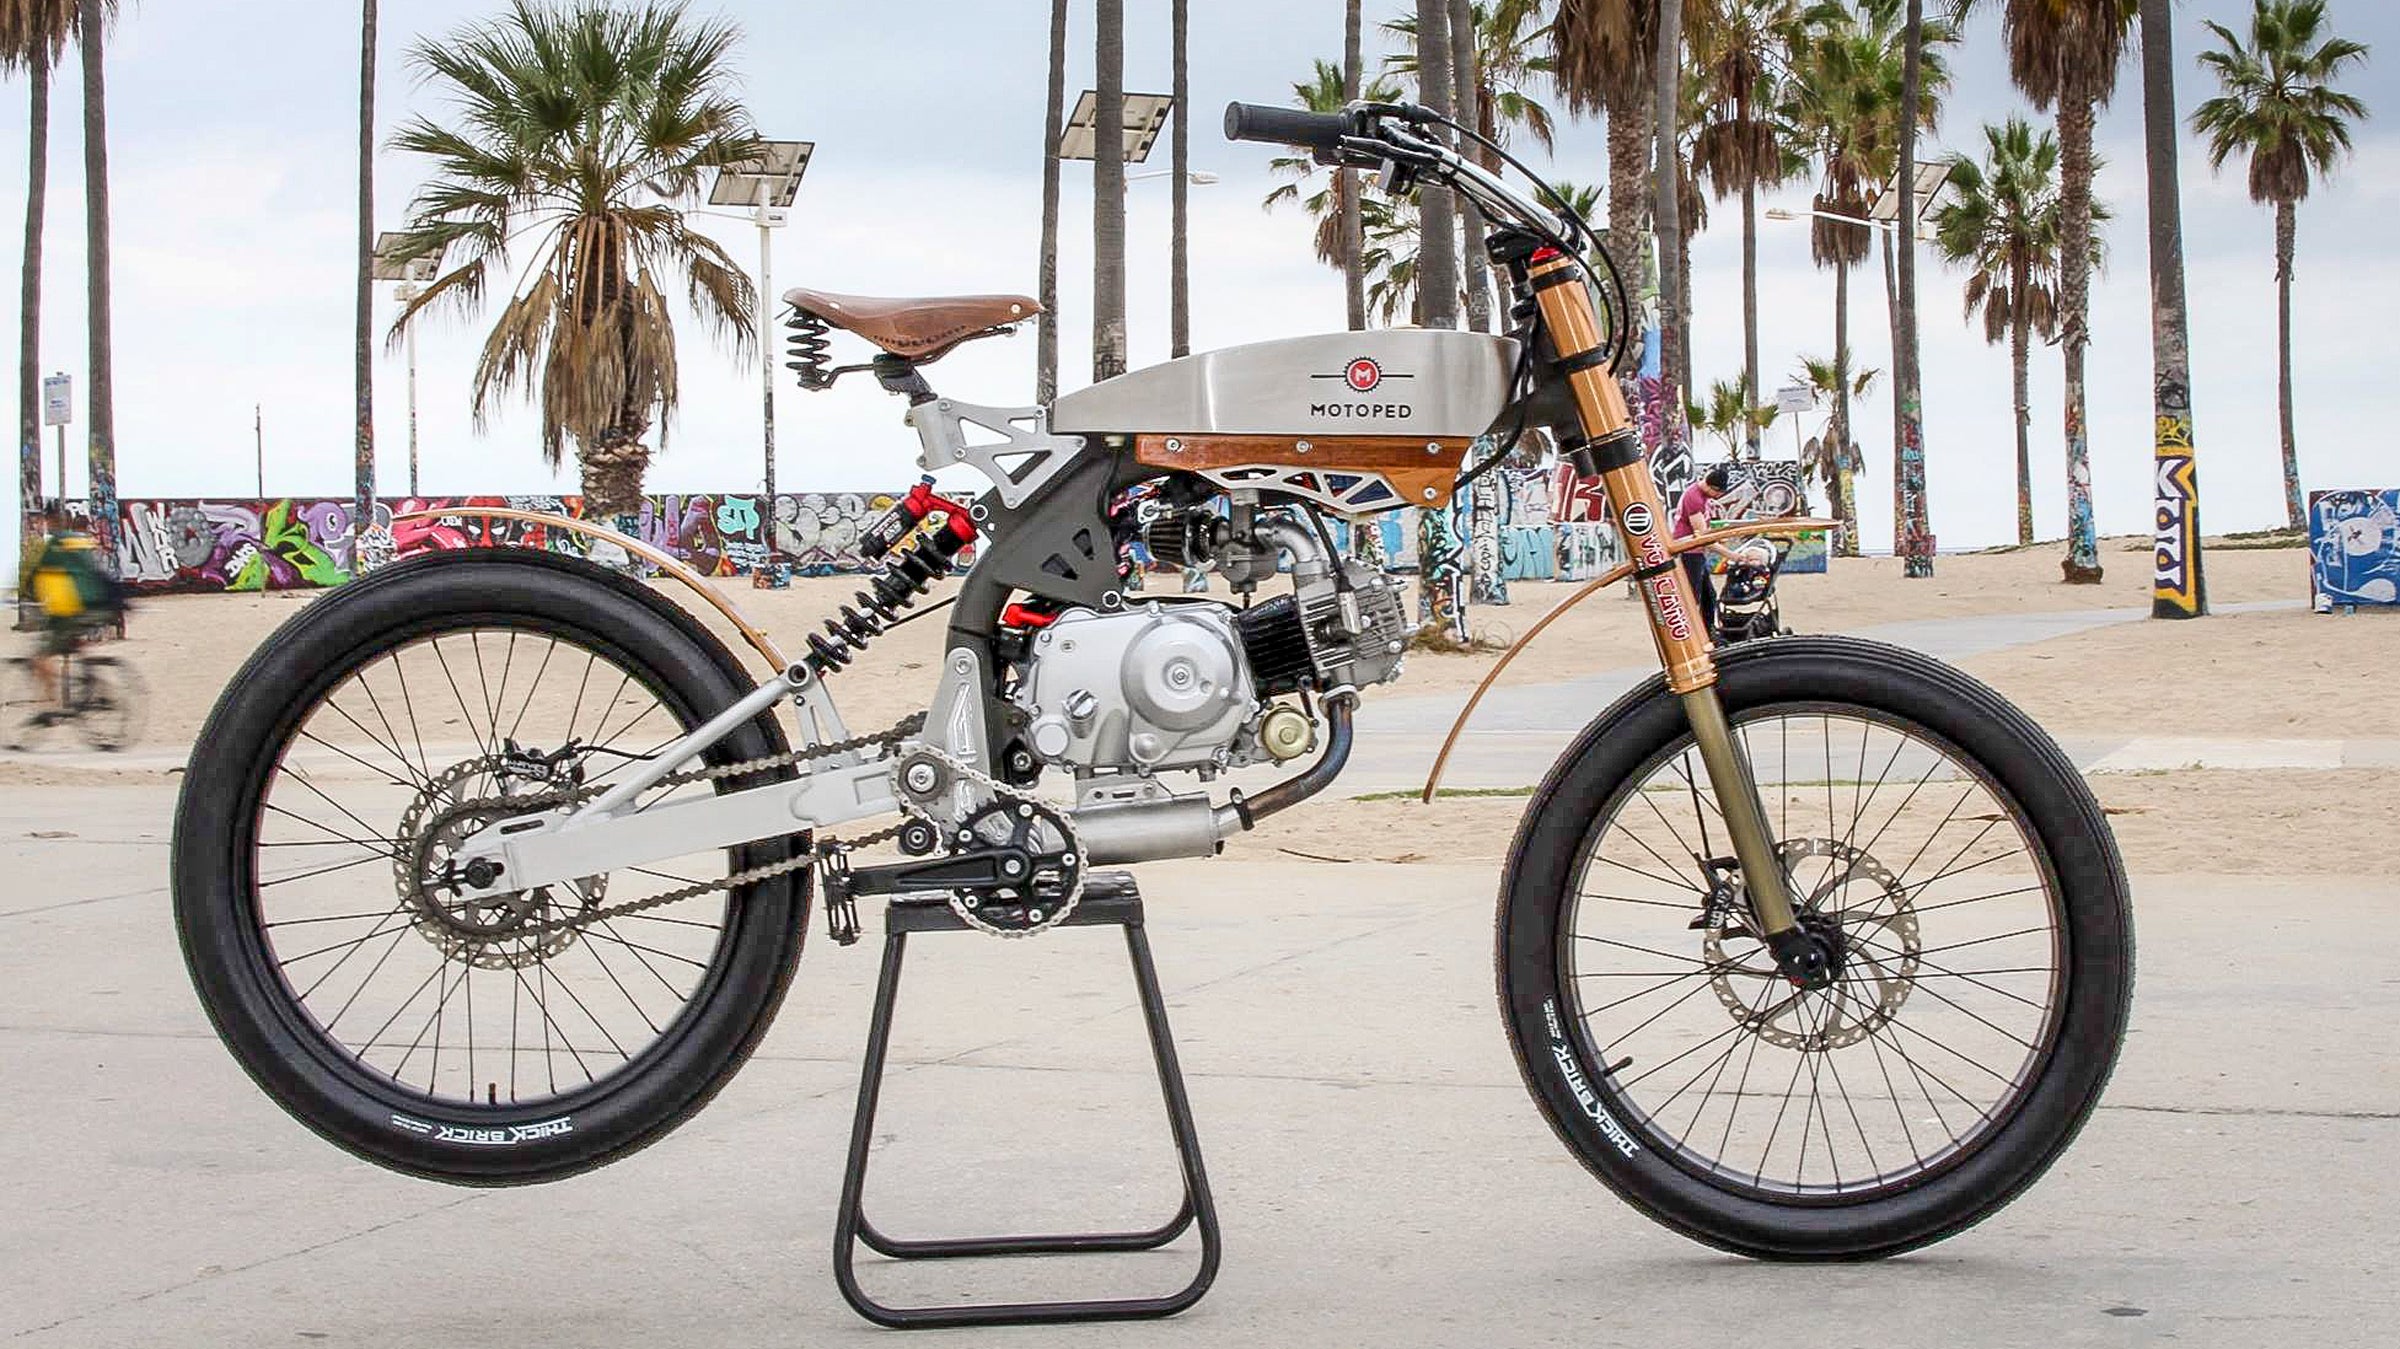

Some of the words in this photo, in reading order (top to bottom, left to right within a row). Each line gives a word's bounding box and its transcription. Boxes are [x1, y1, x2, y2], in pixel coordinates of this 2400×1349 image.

[1310, 403, 1412, 419] MOTOPED
[1641, 533, 1692, 640] VOCANO
[1553, 1044, 1595, 1116] BRICK
[434, 1125, 513, 1144] BRICK
[508, 1116, 574, 1142] THICK
[1593, 1102, 1640, 1159] THICK
